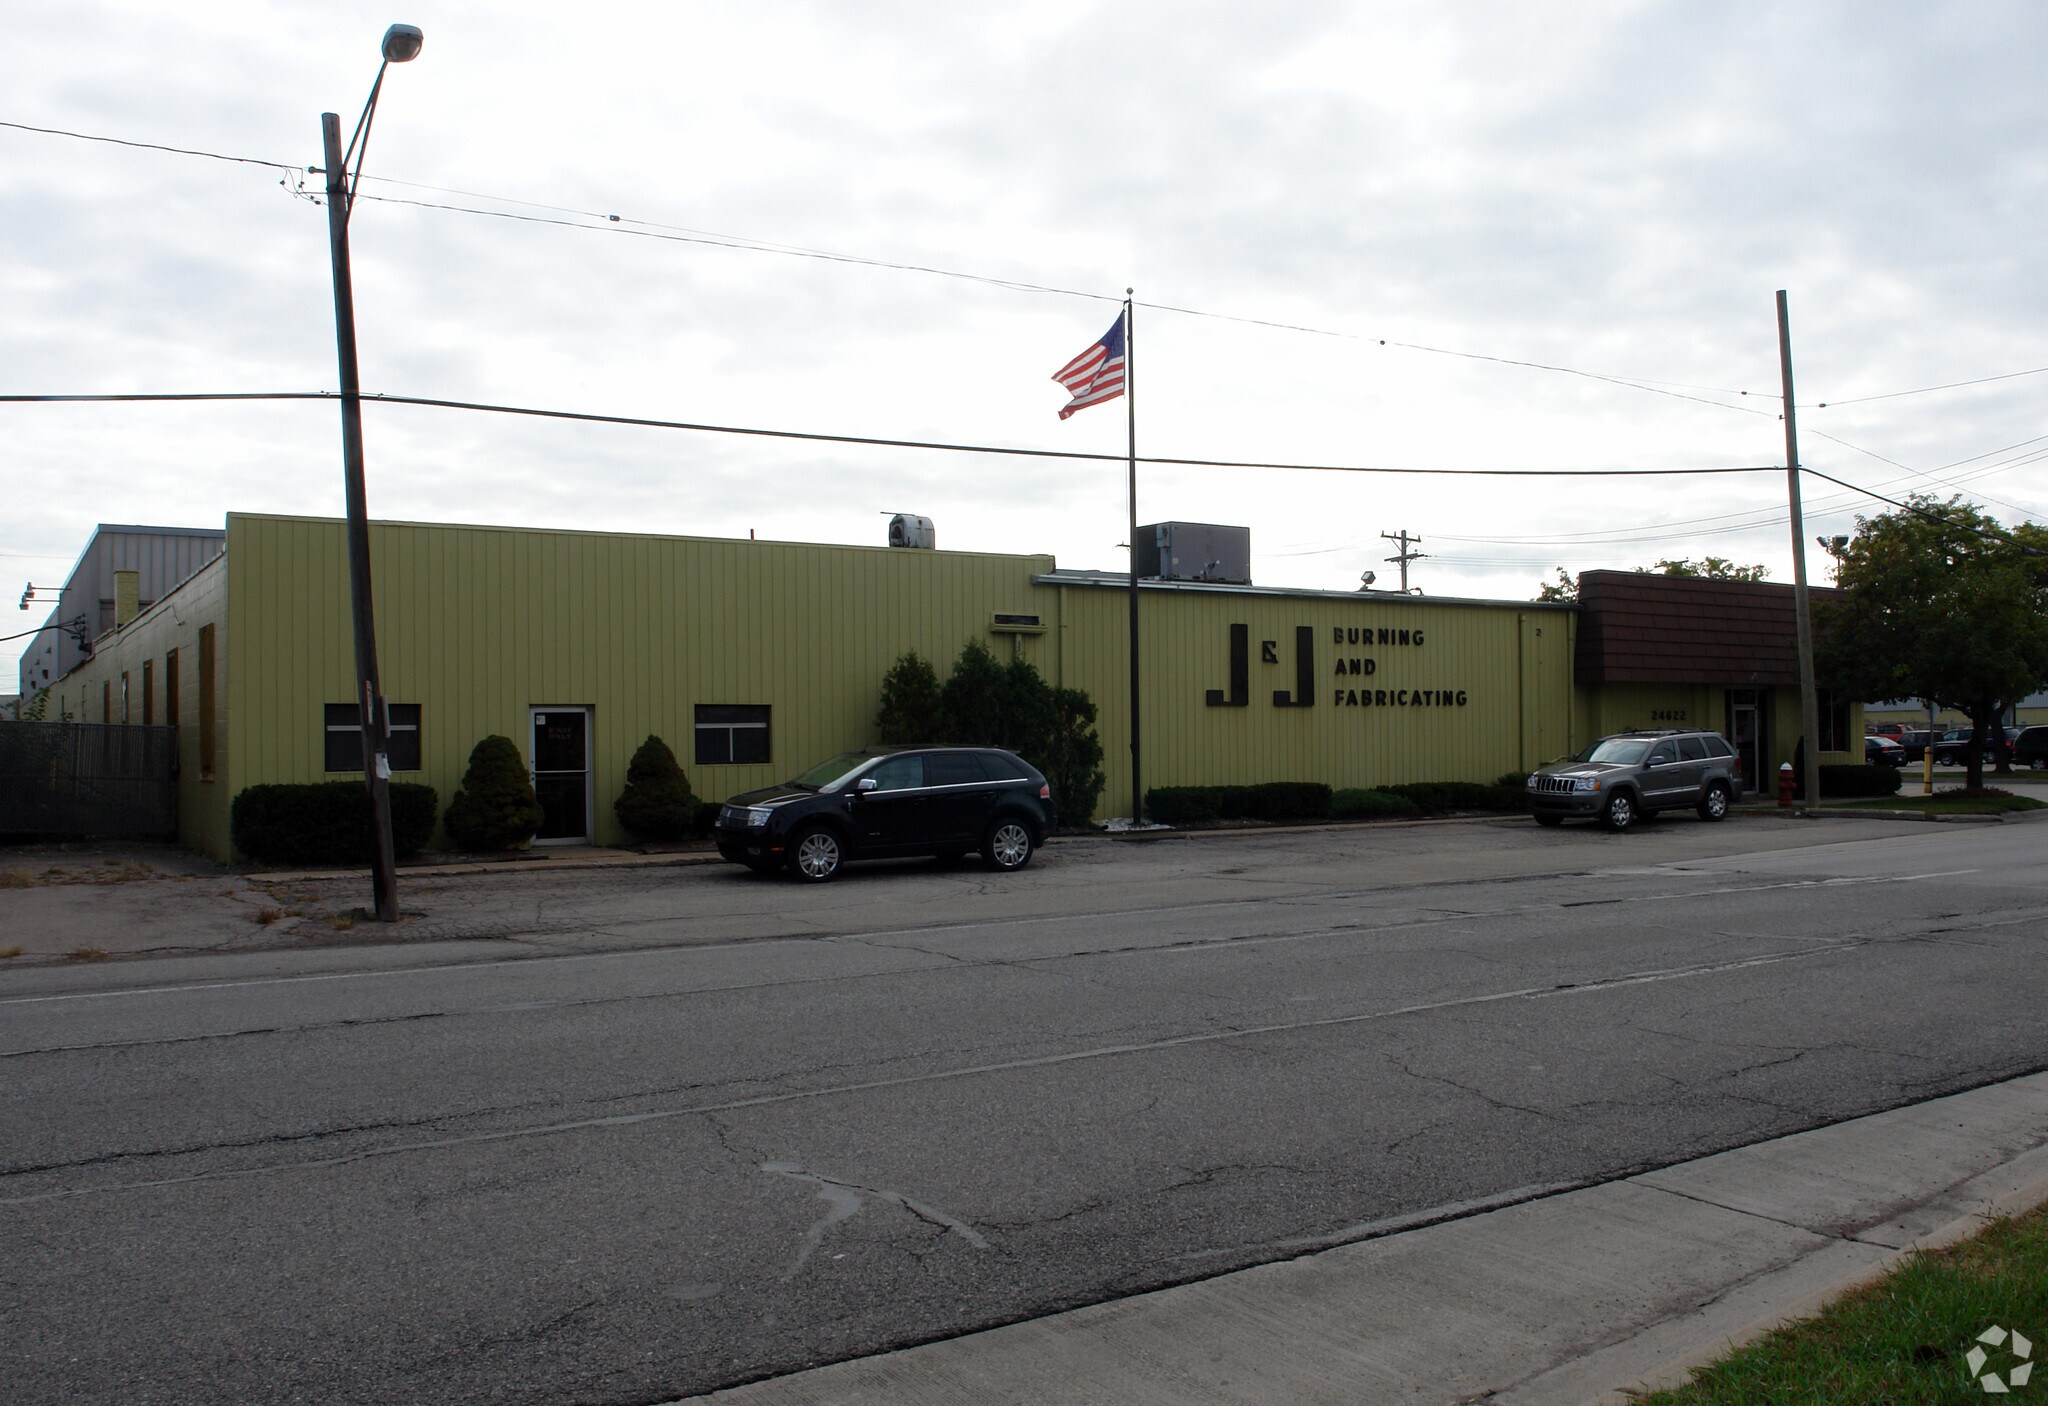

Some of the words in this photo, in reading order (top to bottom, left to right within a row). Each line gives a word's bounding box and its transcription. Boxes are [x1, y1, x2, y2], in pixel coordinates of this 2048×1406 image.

[1333, 627, 1425, 646] BURNING
[1335, 658, 1376, 676] AND
[1334, 689, 1468, 707] FABRICATING
[1651, 710, 1687, 721] 24622
